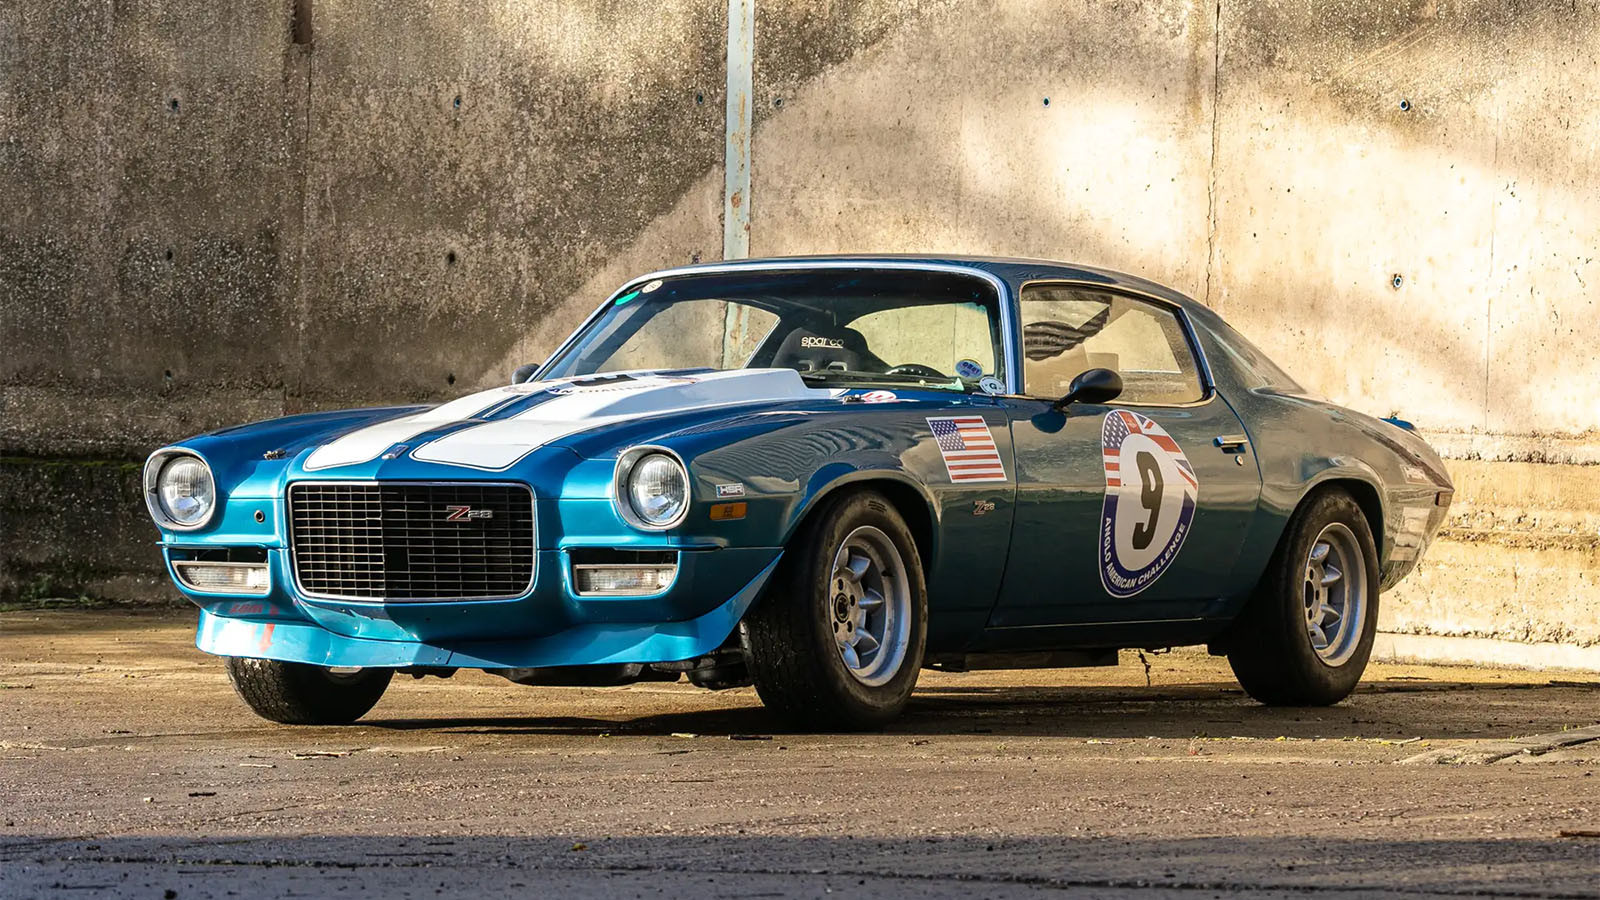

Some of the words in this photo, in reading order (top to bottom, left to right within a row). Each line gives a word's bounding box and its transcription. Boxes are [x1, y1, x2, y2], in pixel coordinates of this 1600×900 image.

[801, 336, 844, 348] sparco
[446, 505, 493, 521] Z28
[973, 500, 995, 515] Z28
[1132, 451, 1164, 550] 9
[1104, 517, 1112, 563] ANGLO
[1138, 523, 1186, 585] CHALLENGE
[1106, 561, 1137, 588] AMERICAN
